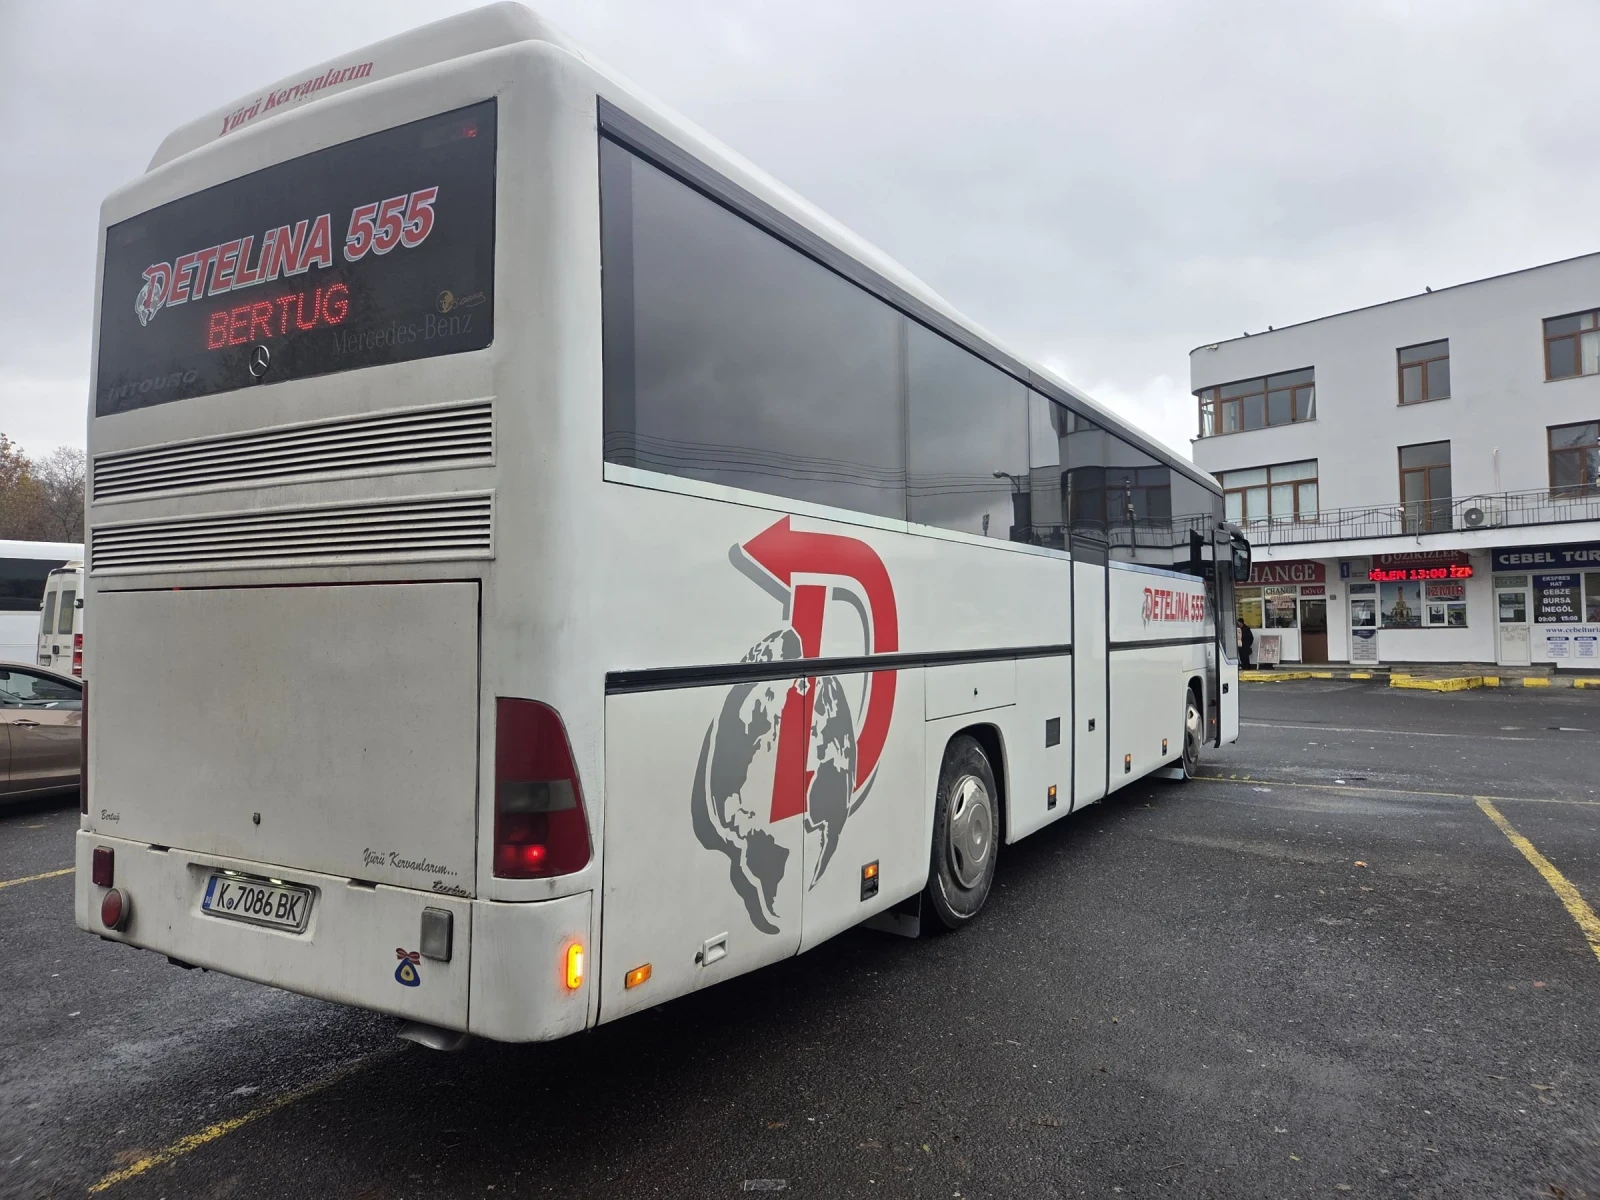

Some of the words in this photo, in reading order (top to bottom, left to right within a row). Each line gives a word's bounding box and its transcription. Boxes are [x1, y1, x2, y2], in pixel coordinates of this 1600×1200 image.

[218, 98, 262, 137] Yürü
[265, 61, 374, 110] Kervanlarım
[343, 186, 439, 262] 555
[207, 283, 350, 351] BERTUG
[331, 313, 473, 356] Mercedes-Benz
[1499, 552, 1555, 565] CEBEL
[1562, 549, 1600, 562] TUR
[1237, 563, 1316, 583] HANGE
[1410, 569, 1447, 580] 13:00
[1191, 595, 1205, 622] 555
[1542, 605, 1574, 613] İNEGÖL
[363, 847, 386, 867] Yürü
[233, 885, 275, 917] 7086
[275, 892, 302, 922] BK
